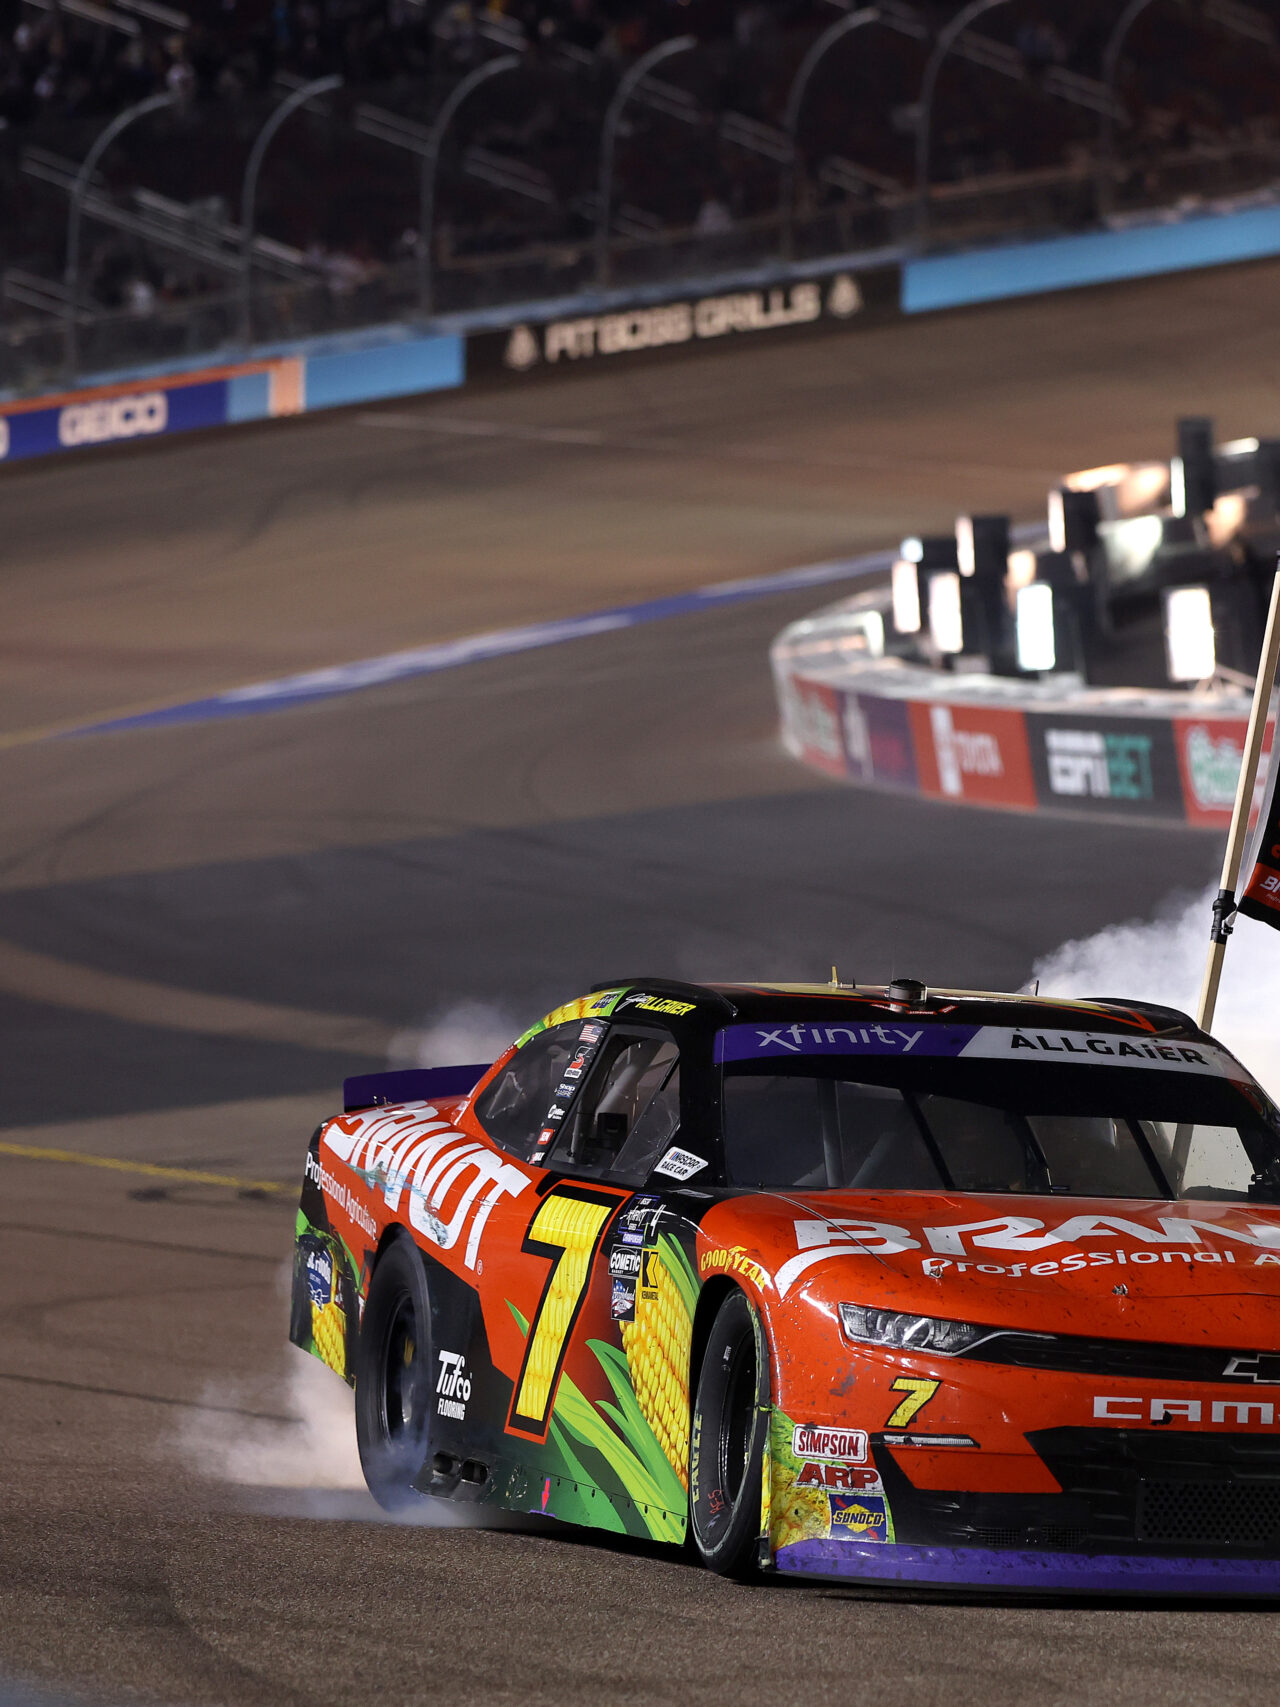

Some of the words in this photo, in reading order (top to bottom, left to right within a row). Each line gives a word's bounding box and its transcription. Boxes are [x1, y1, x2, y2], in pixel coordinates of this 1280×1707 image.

[58, 390, 168, 445] GEICO
[635, 996, 697, 1016] ALLGAIER
[756, 1023, 924, 1052] xfinity
[1010, 1034, 1209, 1066] ALLGAIER
[661, 1161, 677, 1172] RACE
[673, 1165, 689, 1176] CAR
[674, 1151, 701, 1169] NASCAR
[305, 1152, 347, 1218] Professional
[348, 1192, 378, 1241] Agriculture
[323, 1100, 532, 1271] BRANDT
[610, 1252, 641, 1272] COMETIC
[922, 1250, 1235, 1277] Professional
[510, 1188, 620, 1430] 7
[436, 1349, 471, 1402] Tufco
[437, 1398, 466, 1420] FLOORING
[885, 1375, 944, 1429] 7
[798, 1430, 860, 1457] SIMPSON
[796, 1463, 879, 1489] ARP
[834, 1511, 884, 1526] SUNOCO
